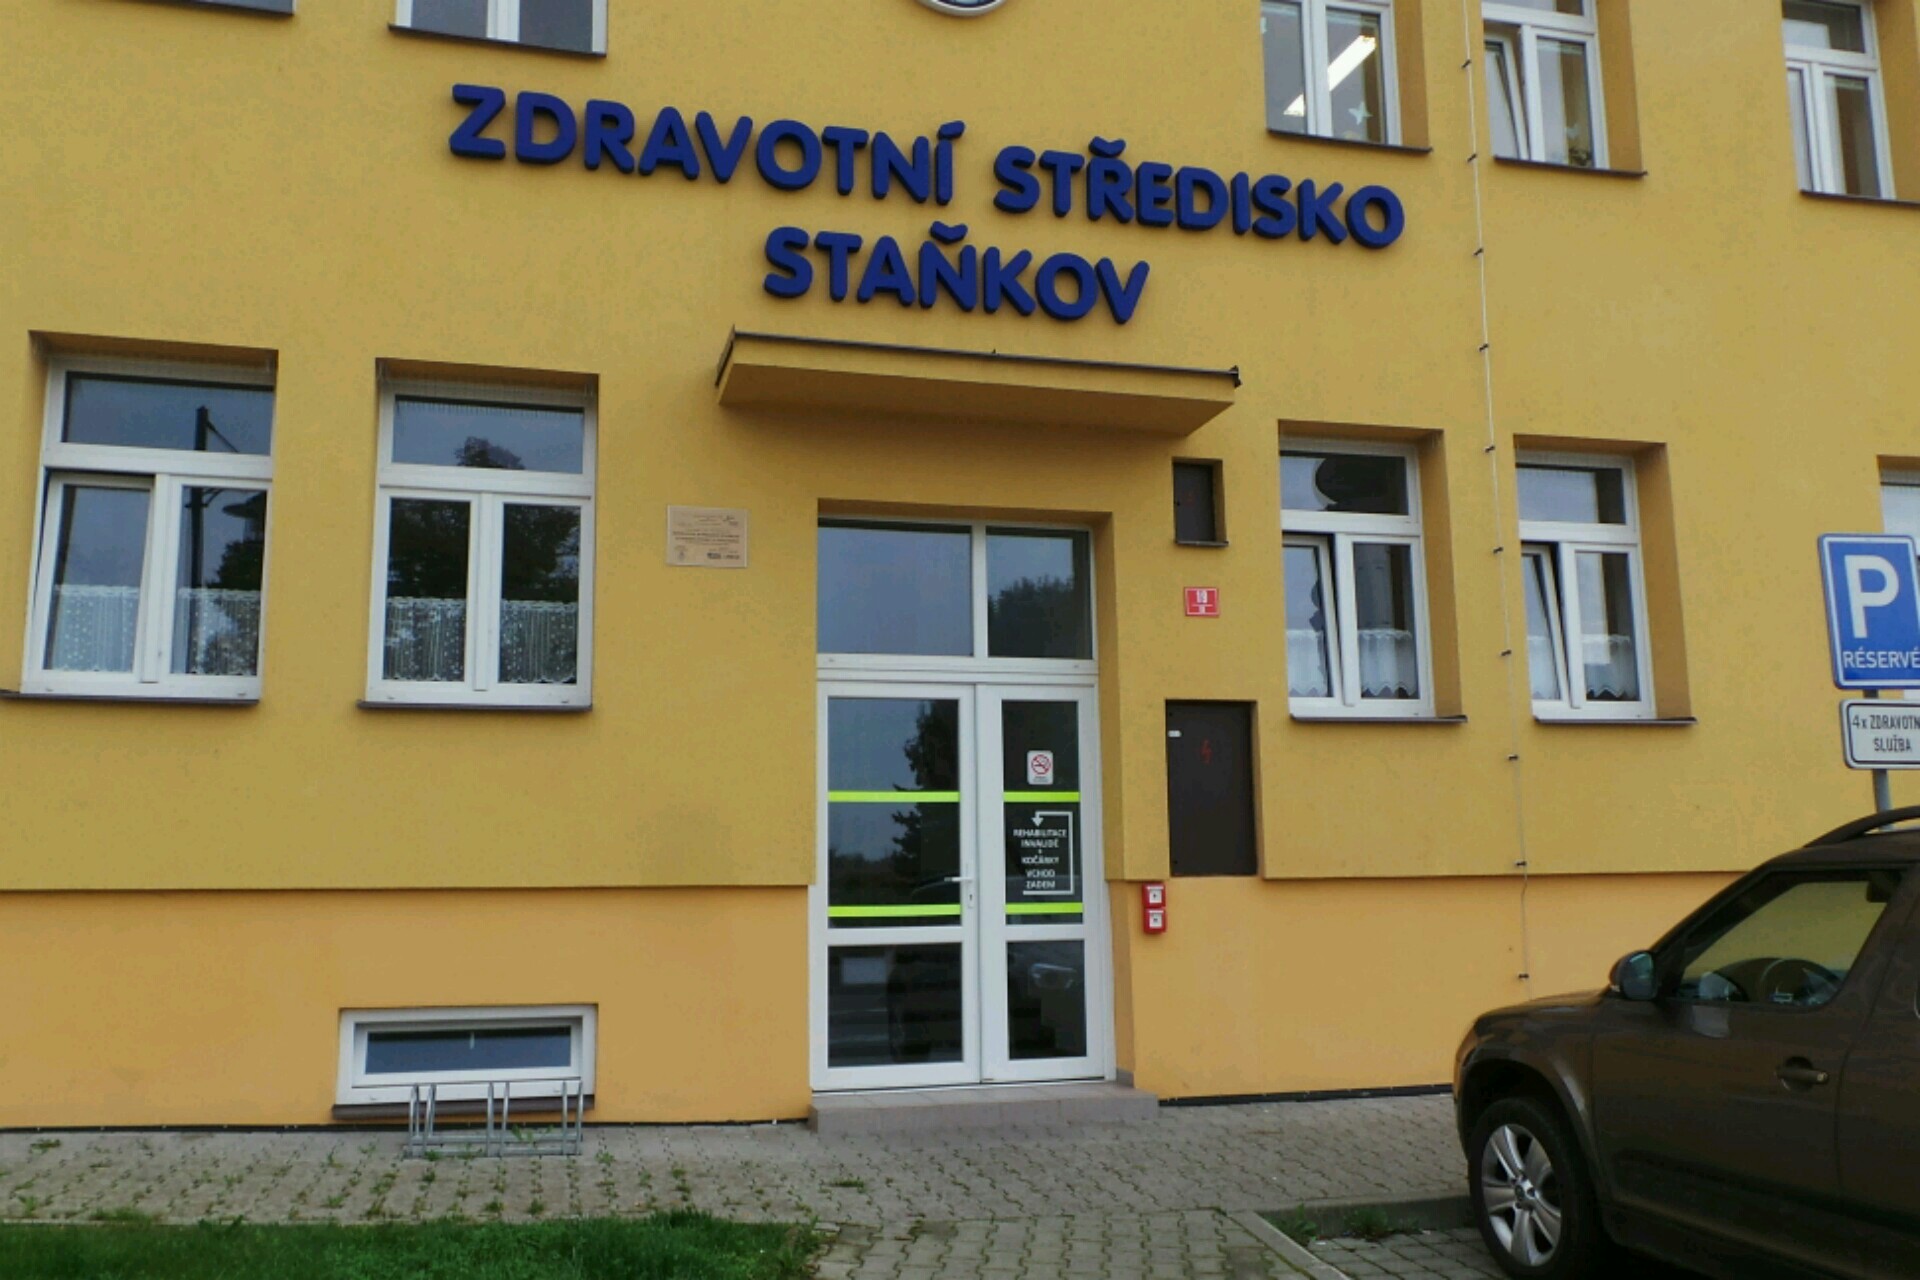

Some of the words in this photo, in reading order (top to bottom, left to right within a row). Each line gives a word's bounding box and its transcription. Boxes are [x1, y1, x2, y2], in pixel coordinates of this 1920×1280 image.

[449, 83, 965, 206] ZDRAVOTNÍ
[993, 136, 1405, 249] STŘEDISKO
[764, 220, 1150, 325] STAŇKOV
[1844, 554, 1900, 639] P
[1843, 647, 1920, 668] RÉSERVÉ
[1851, 714, 1867, 729] 4x
[1869, 714, 1920, 730] ZDRAVOTN
[1873, 734, 1912, 754] SLUŽBA
